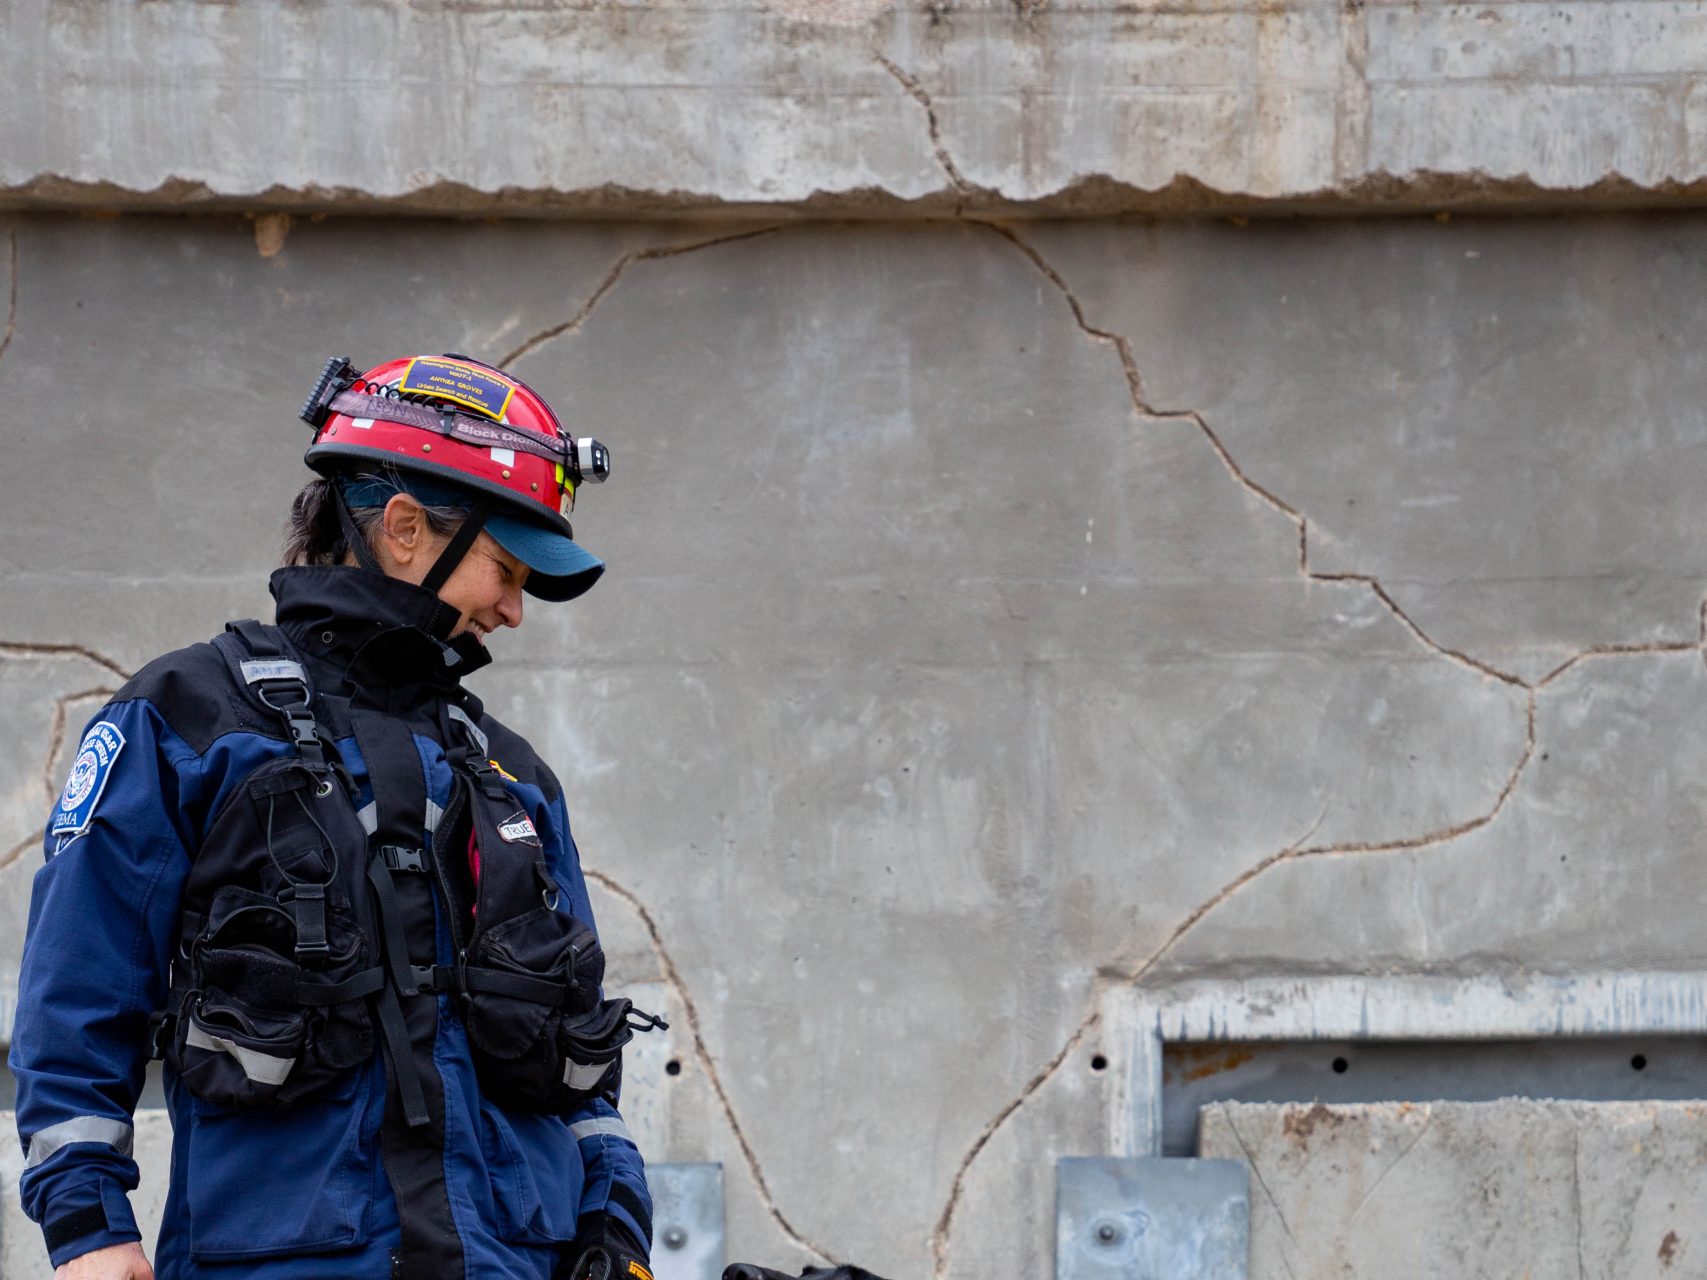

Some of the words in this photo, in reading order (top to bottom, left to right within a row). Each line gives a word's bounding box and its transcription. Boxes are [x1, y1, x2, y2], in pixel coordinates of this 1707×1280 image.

[429, 375, 455, 386] ANTHEA
[456, 382, 484, 395] GROVES
[416, 382, 435, 391] Urban
[434, 386, 455, 395] Search
[456, 390, 467, 399] and
[467, 393, 489, 408] Rescue
[457, 423, 499, 440] Black
[504, 822, 532, 836] TRUE
